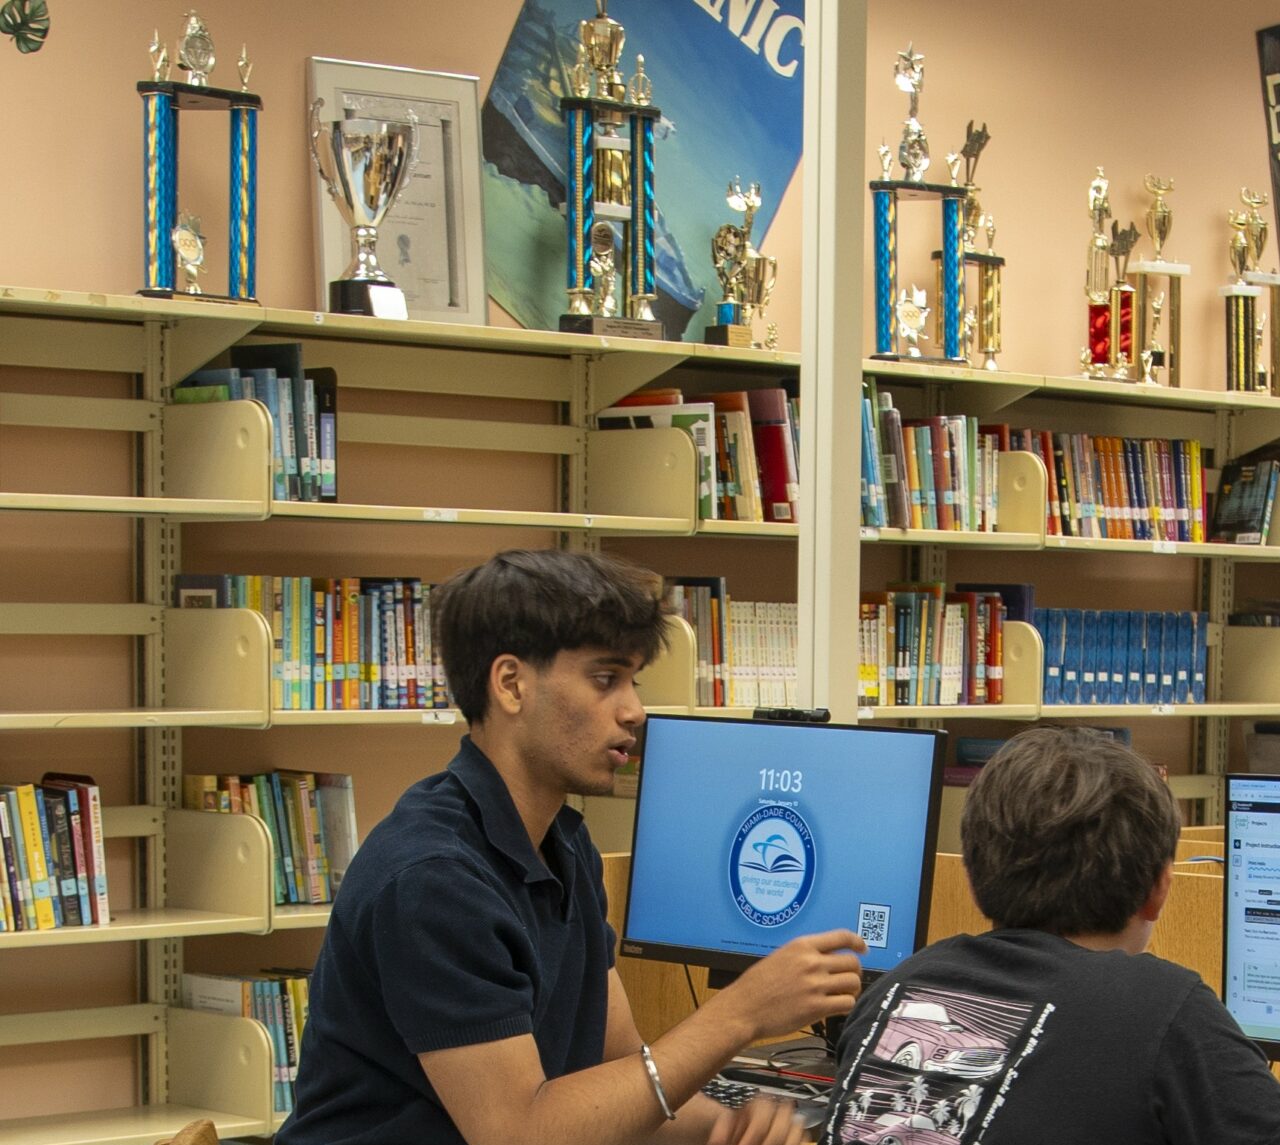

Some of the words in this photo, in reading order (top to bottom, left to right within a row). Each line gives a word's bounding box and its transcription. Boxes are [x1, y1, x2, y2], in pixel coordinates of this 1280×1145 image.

[759, 768, 803, 793] 11:03
[742, 807, 784, 835] MIAMI-DADE
[785, 811, 811, 841] COUNTY
[737, 894, 762, 923] PUBLIC
[761, 901, 800, 925] SCHOOLS
